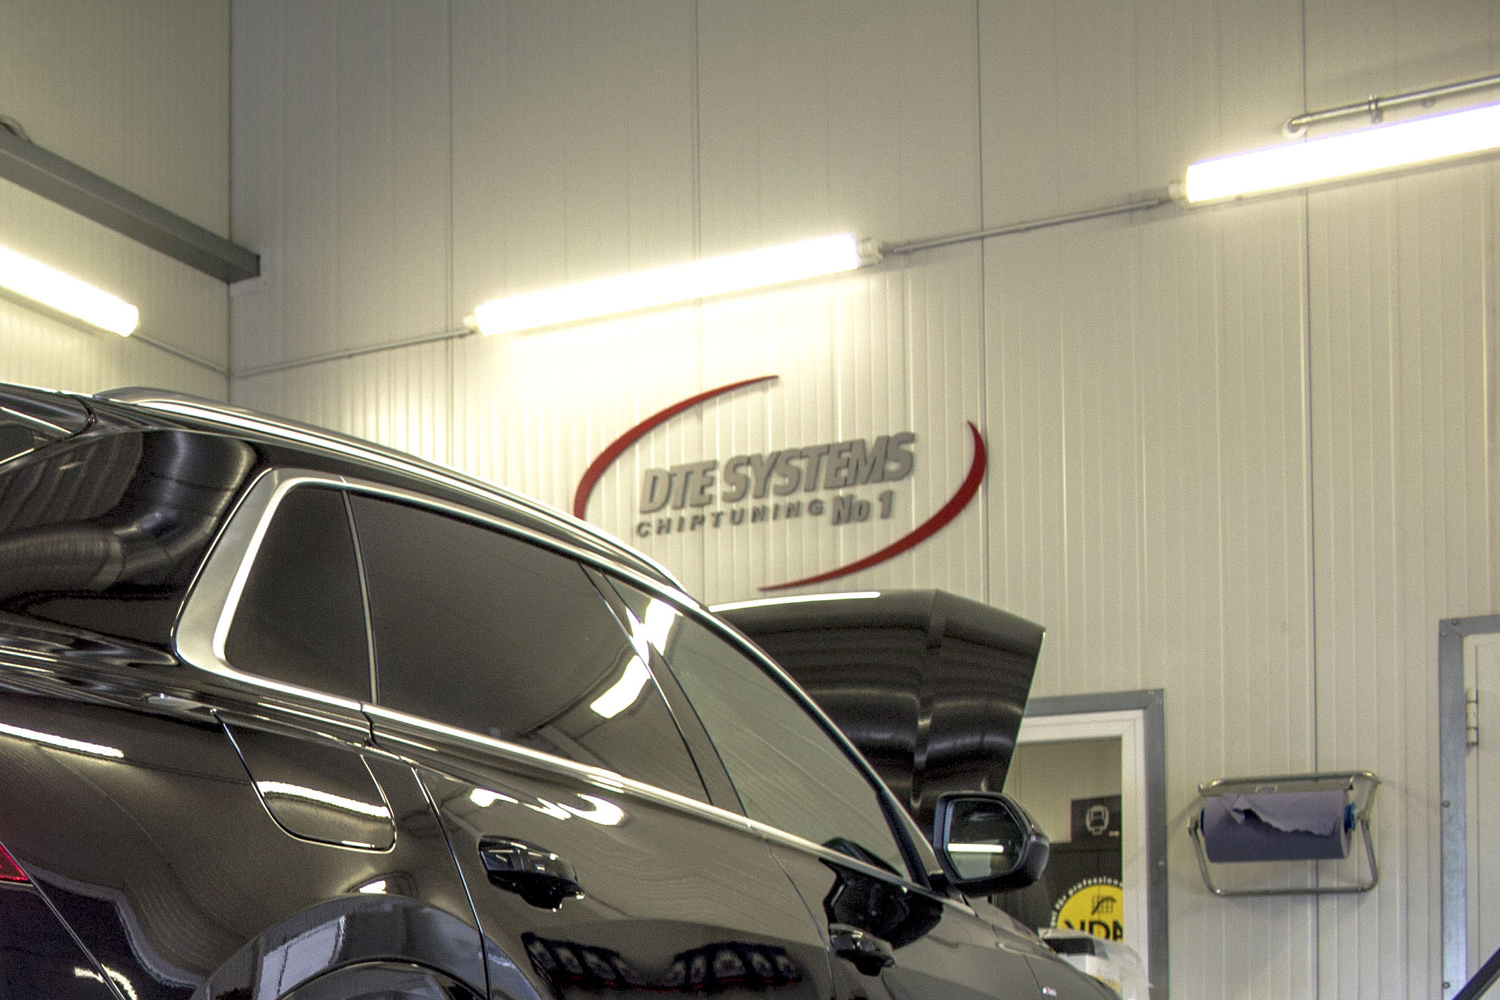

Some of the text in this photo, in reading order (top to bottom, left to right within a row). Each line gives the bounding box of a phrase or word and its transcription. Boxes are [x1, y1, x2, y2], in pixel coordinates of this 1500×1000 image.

[639, 431, 916, 515] DTE SYSTEMS
[636, 498, 825, 538] CHIPTUNING
[878, 489, 895, 519] 1
